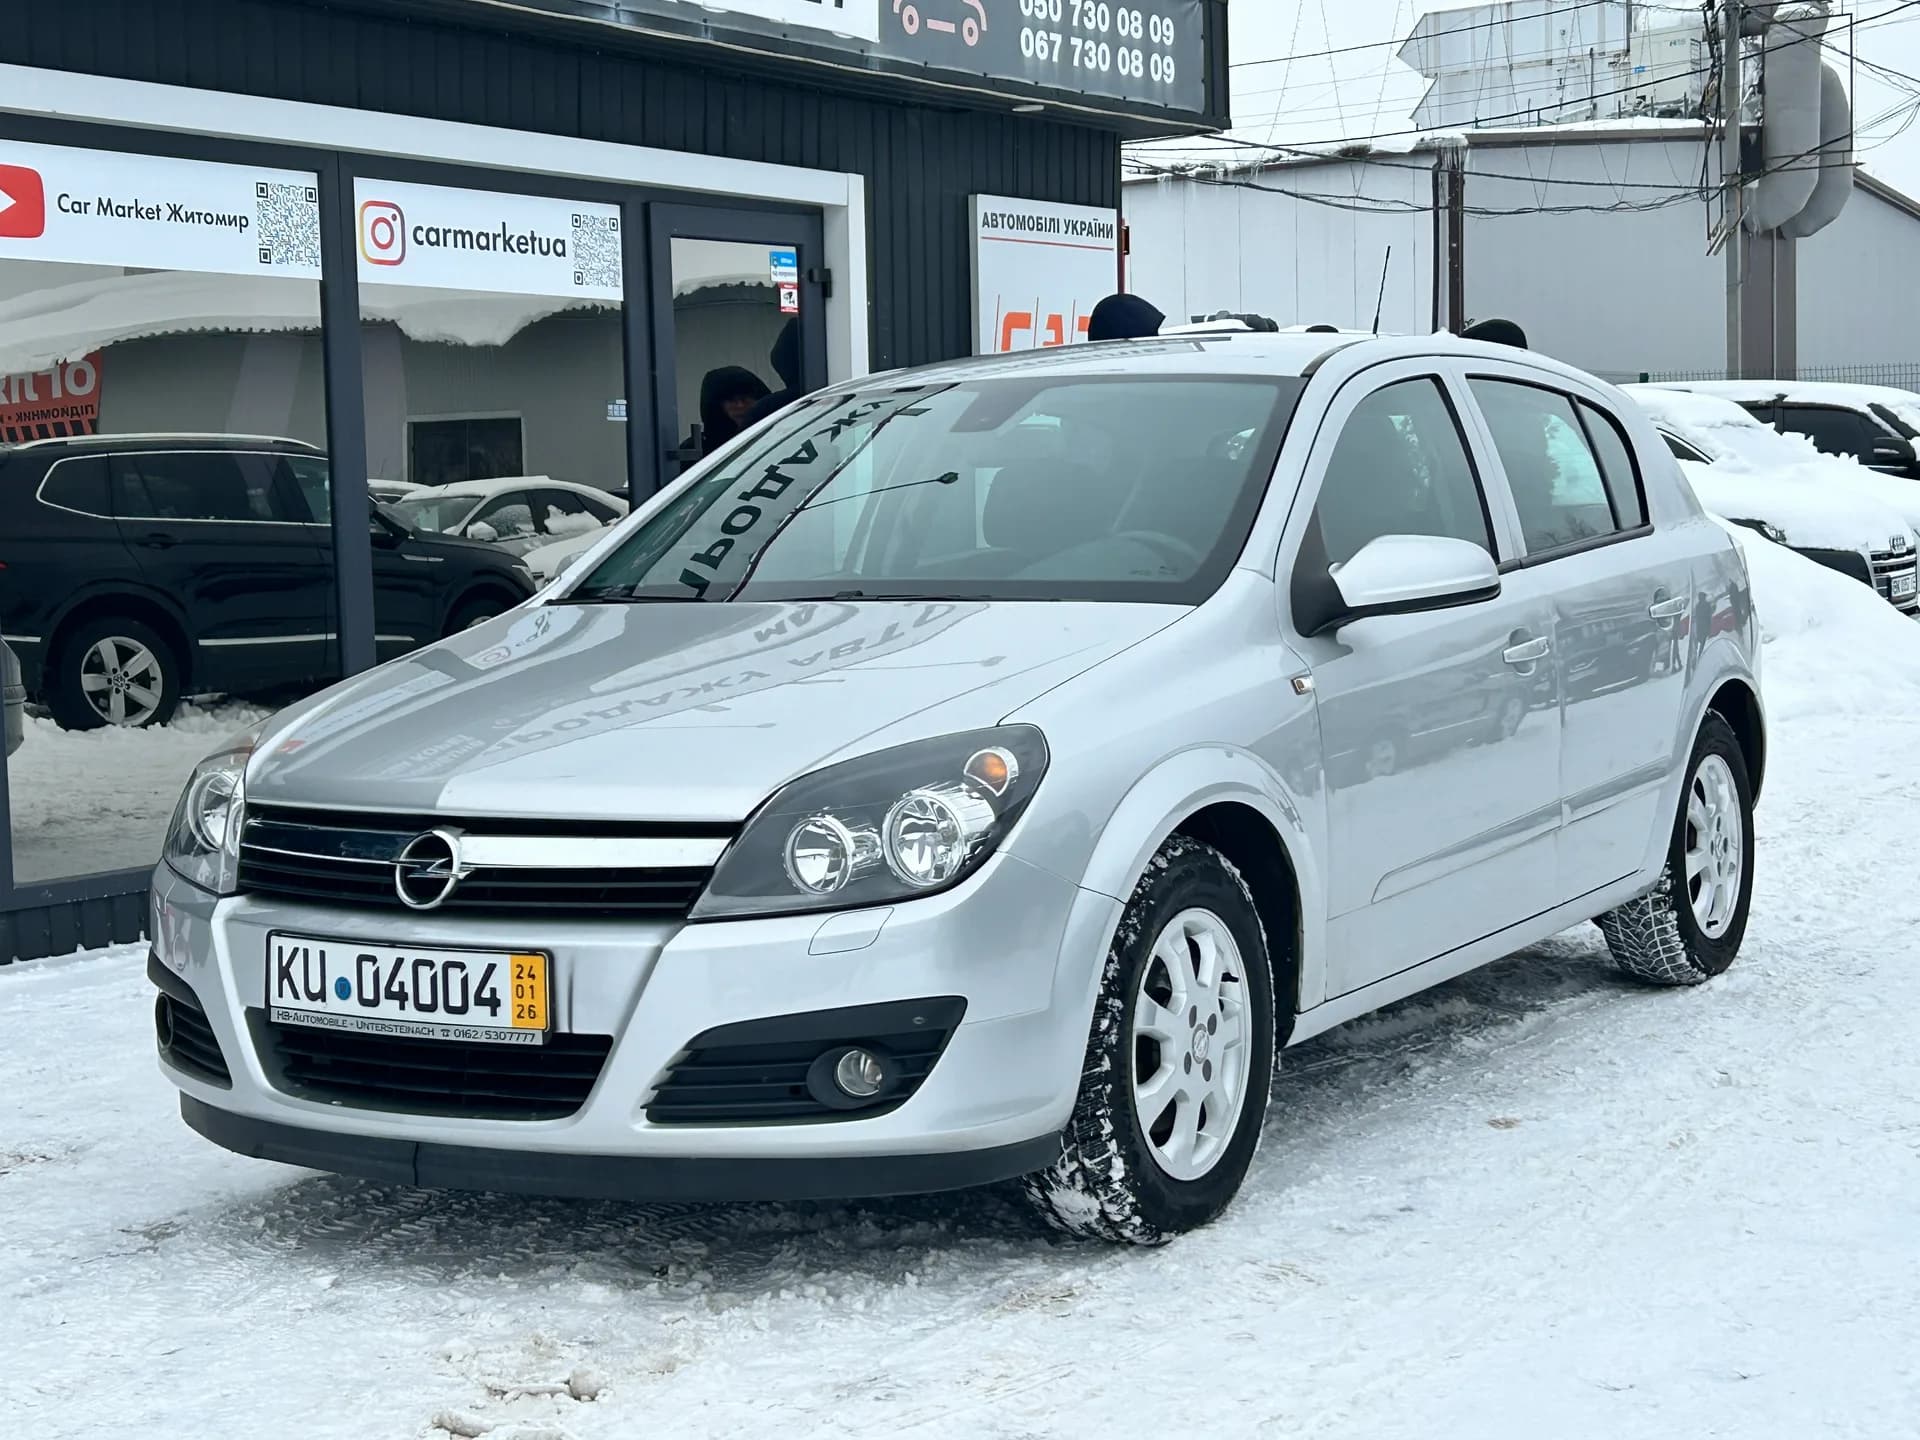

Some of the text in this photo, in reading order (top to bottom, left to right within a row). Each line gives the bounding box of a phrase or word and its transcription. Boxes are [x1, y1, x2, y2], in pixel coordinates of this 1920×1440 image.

[1070, 0, 1110, 32] 730
[1117, 7, 1143, 39] 08
[1150, 14, 1174, 46] 09
[1020, 27, 1175, 84] 067 730 08 09
[57, 193, 249, 233] Car Market Житомир
[982, 211, 1114, 239] АВТОМОБІЛІ УКРАЇНИ
[412, 221, 567, 258] carmarketua
[277, 945, 502, 1017] KU 04004
[515, 963, 537, 981] 24
[515, 984, 536, 1000] 01
[516, 1003, 538, 1020] 26
[356, 1020, 435, 1037] UNTERSTEINACH
[454, 1028, 536, 1043] 0162/5307777
